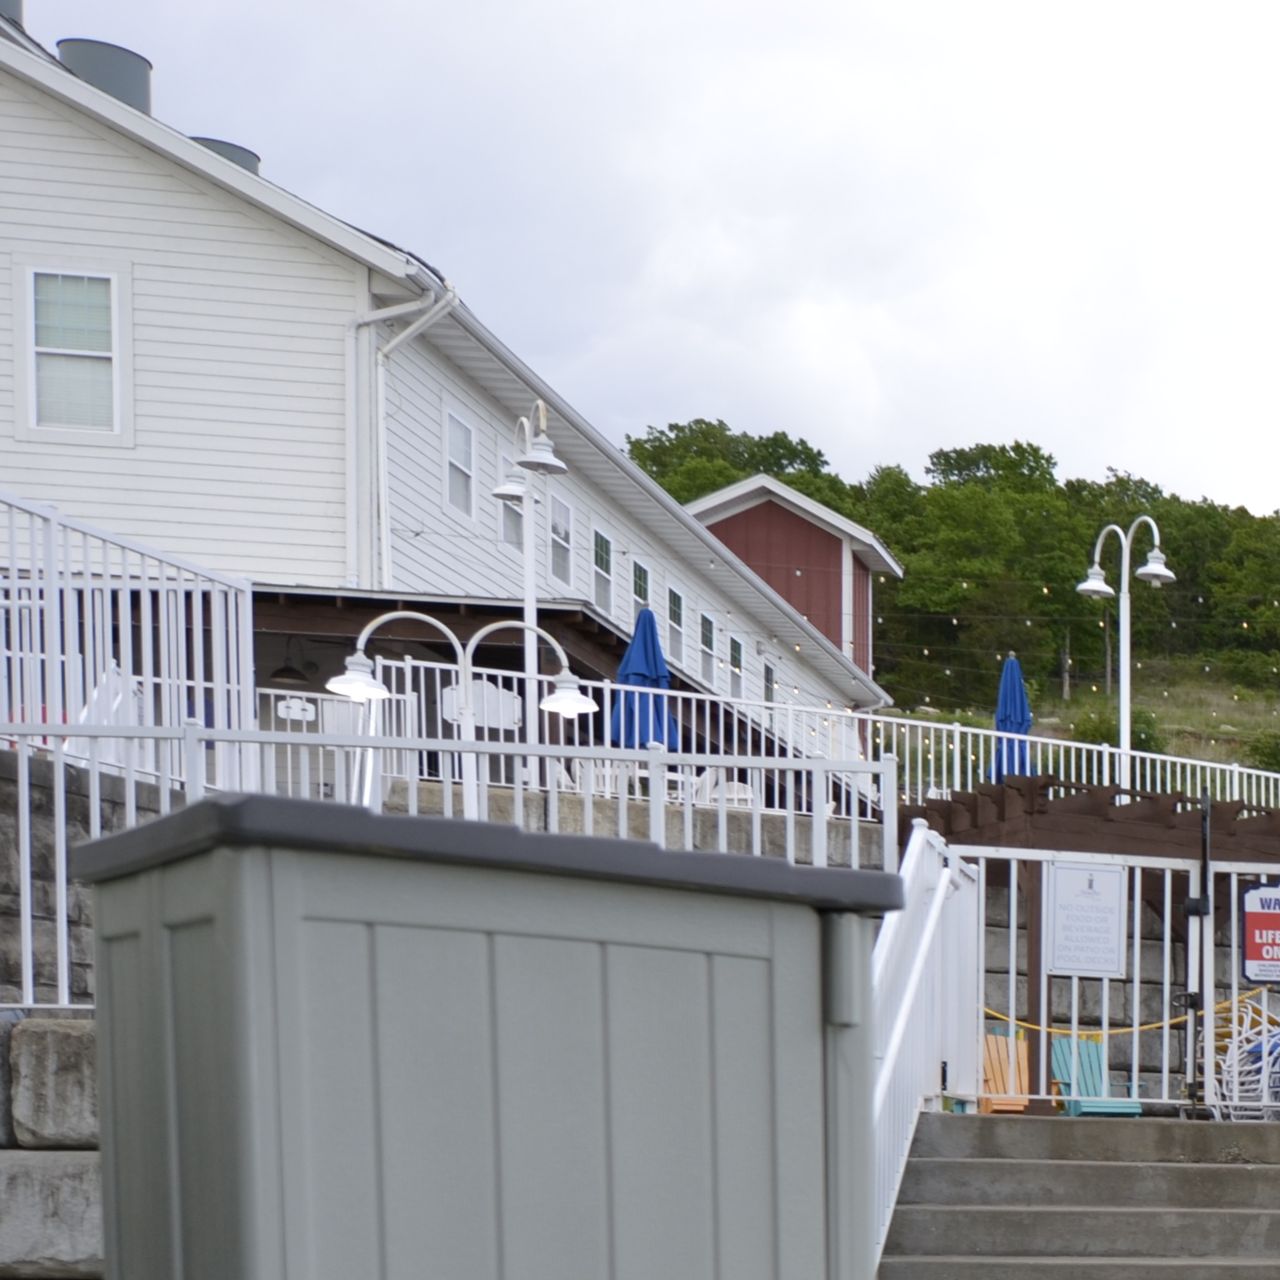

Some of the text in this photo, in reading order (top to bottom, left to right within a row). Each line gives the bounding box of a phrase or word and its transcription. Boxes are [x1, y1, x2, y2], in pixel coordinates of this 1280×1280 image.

[1058, 903, 1074, 912] NO
[1066, 914, 1108, 924] FOOD OR
